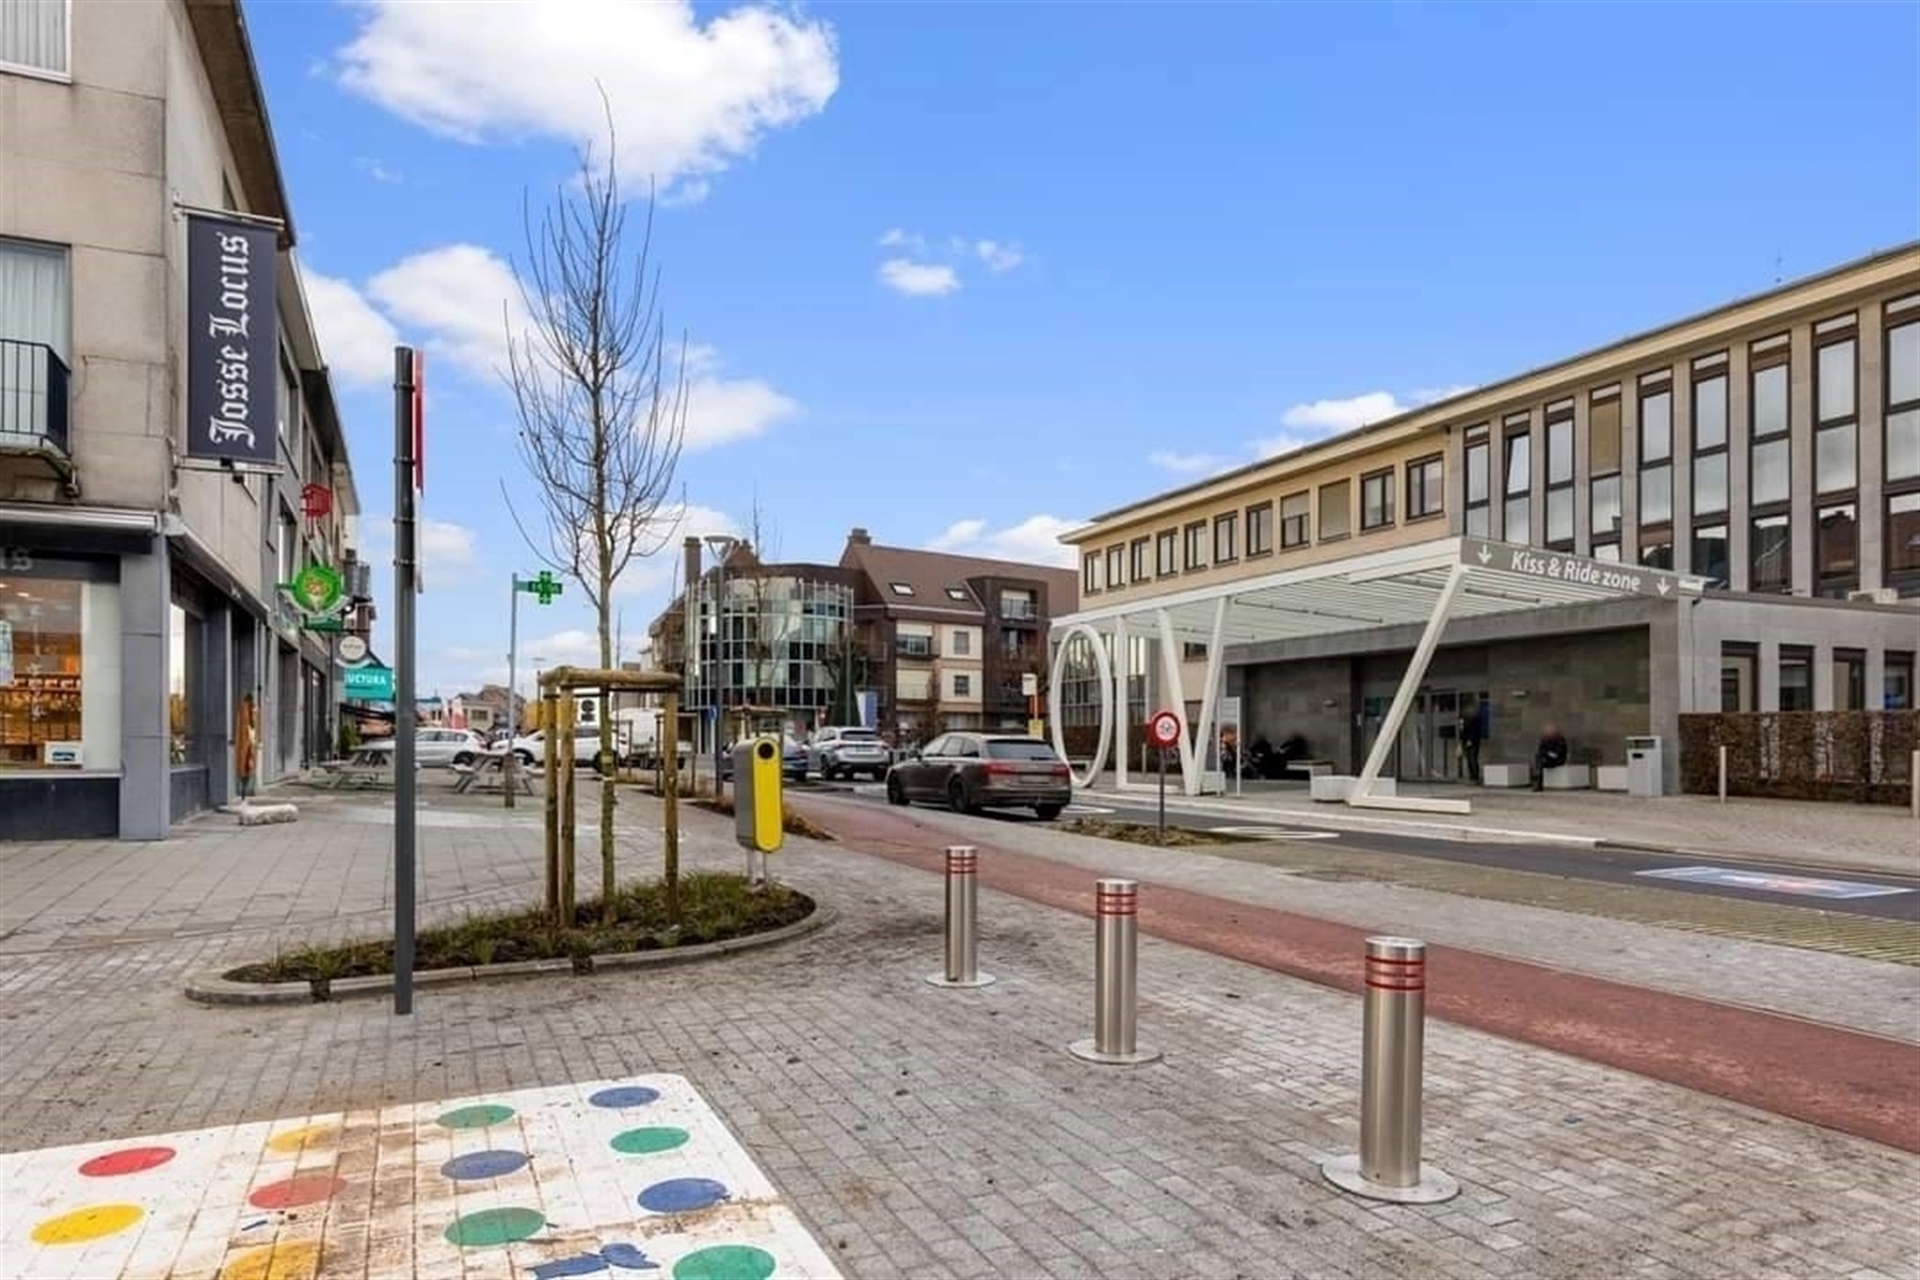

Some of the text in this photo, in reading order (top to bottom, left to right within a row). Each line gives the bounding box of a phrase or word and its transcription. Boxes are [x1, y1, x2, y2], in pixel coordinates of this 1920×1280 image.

[208, 232, 255, 449] Josse Locus
[1511, 550, 1641, 591] Kiss & Ride zone
